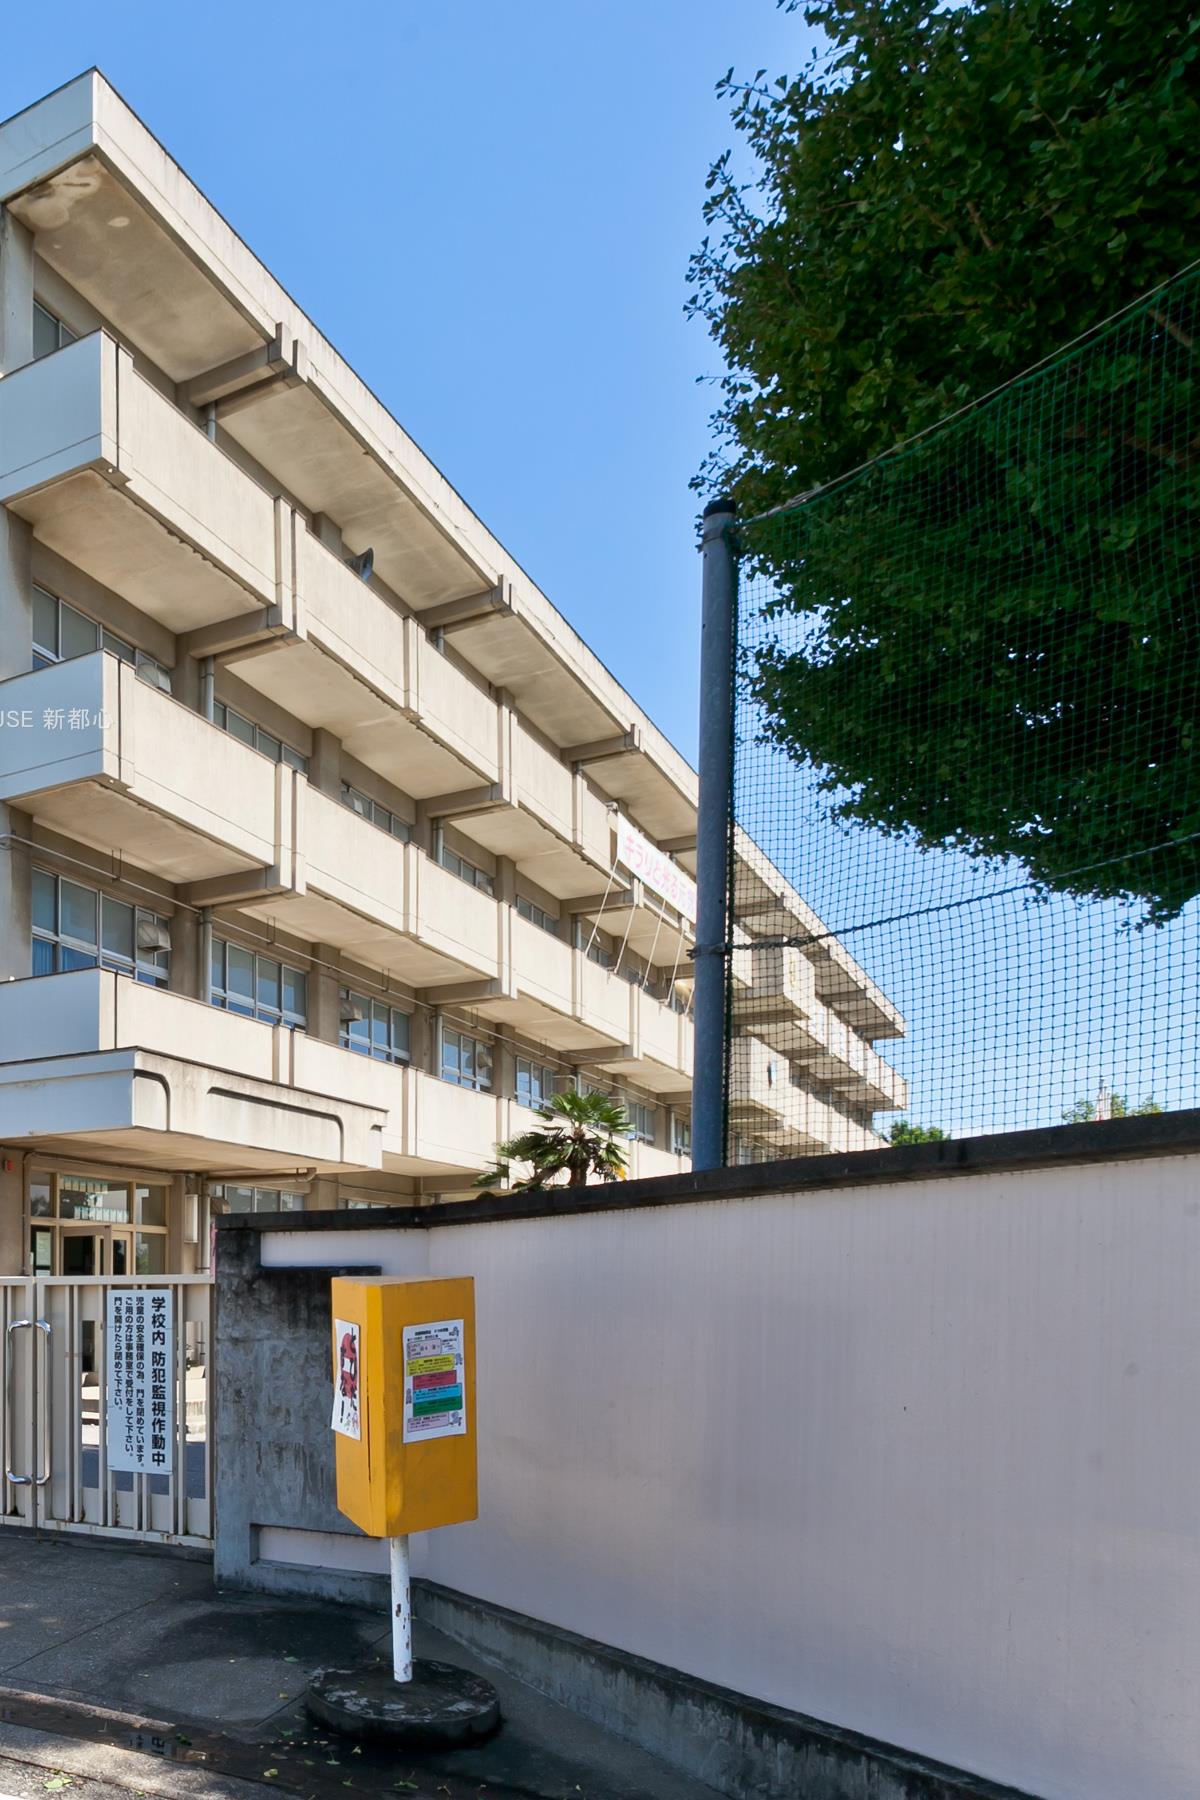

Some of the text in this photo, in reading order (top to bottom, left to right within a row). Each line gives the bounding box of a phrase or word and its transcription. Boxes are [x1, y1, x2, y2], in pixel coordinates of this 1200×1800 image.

[114, 1296, 123, 1410] 門を開けたら閉めて下さい。
